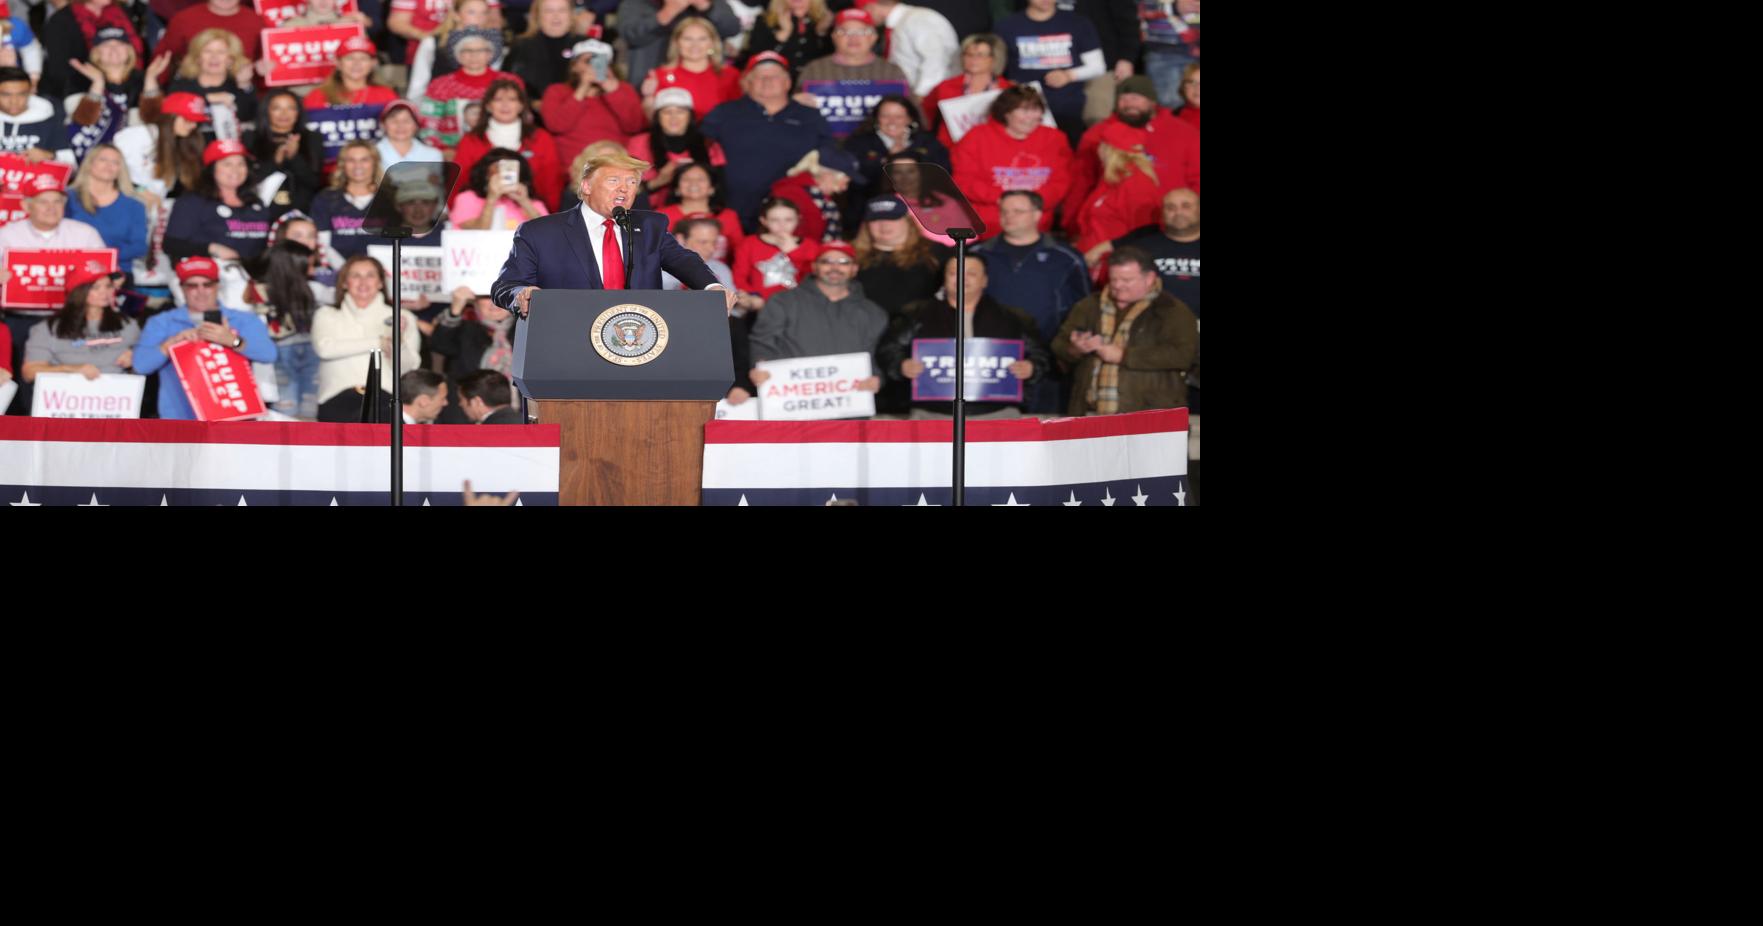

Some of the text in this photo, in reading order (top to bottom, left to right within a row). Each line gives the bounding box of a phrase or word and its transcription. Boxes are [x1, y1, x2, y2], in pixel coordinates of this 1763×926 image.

[271, 39, 341, 56] TRUM
[815, 94, 882, 109] TRUM
[305, 118, 376, 134] TRUM
[12, 263, 67, 277] TRU
[1154, 258, 1200, 268] TRUM
[789, 365, 839, 381] KEEP
[766, 378, 862, 398] AMERICA
[43, 388, 131, 411] Women
[782, 395, 852, 413] GREAT!
